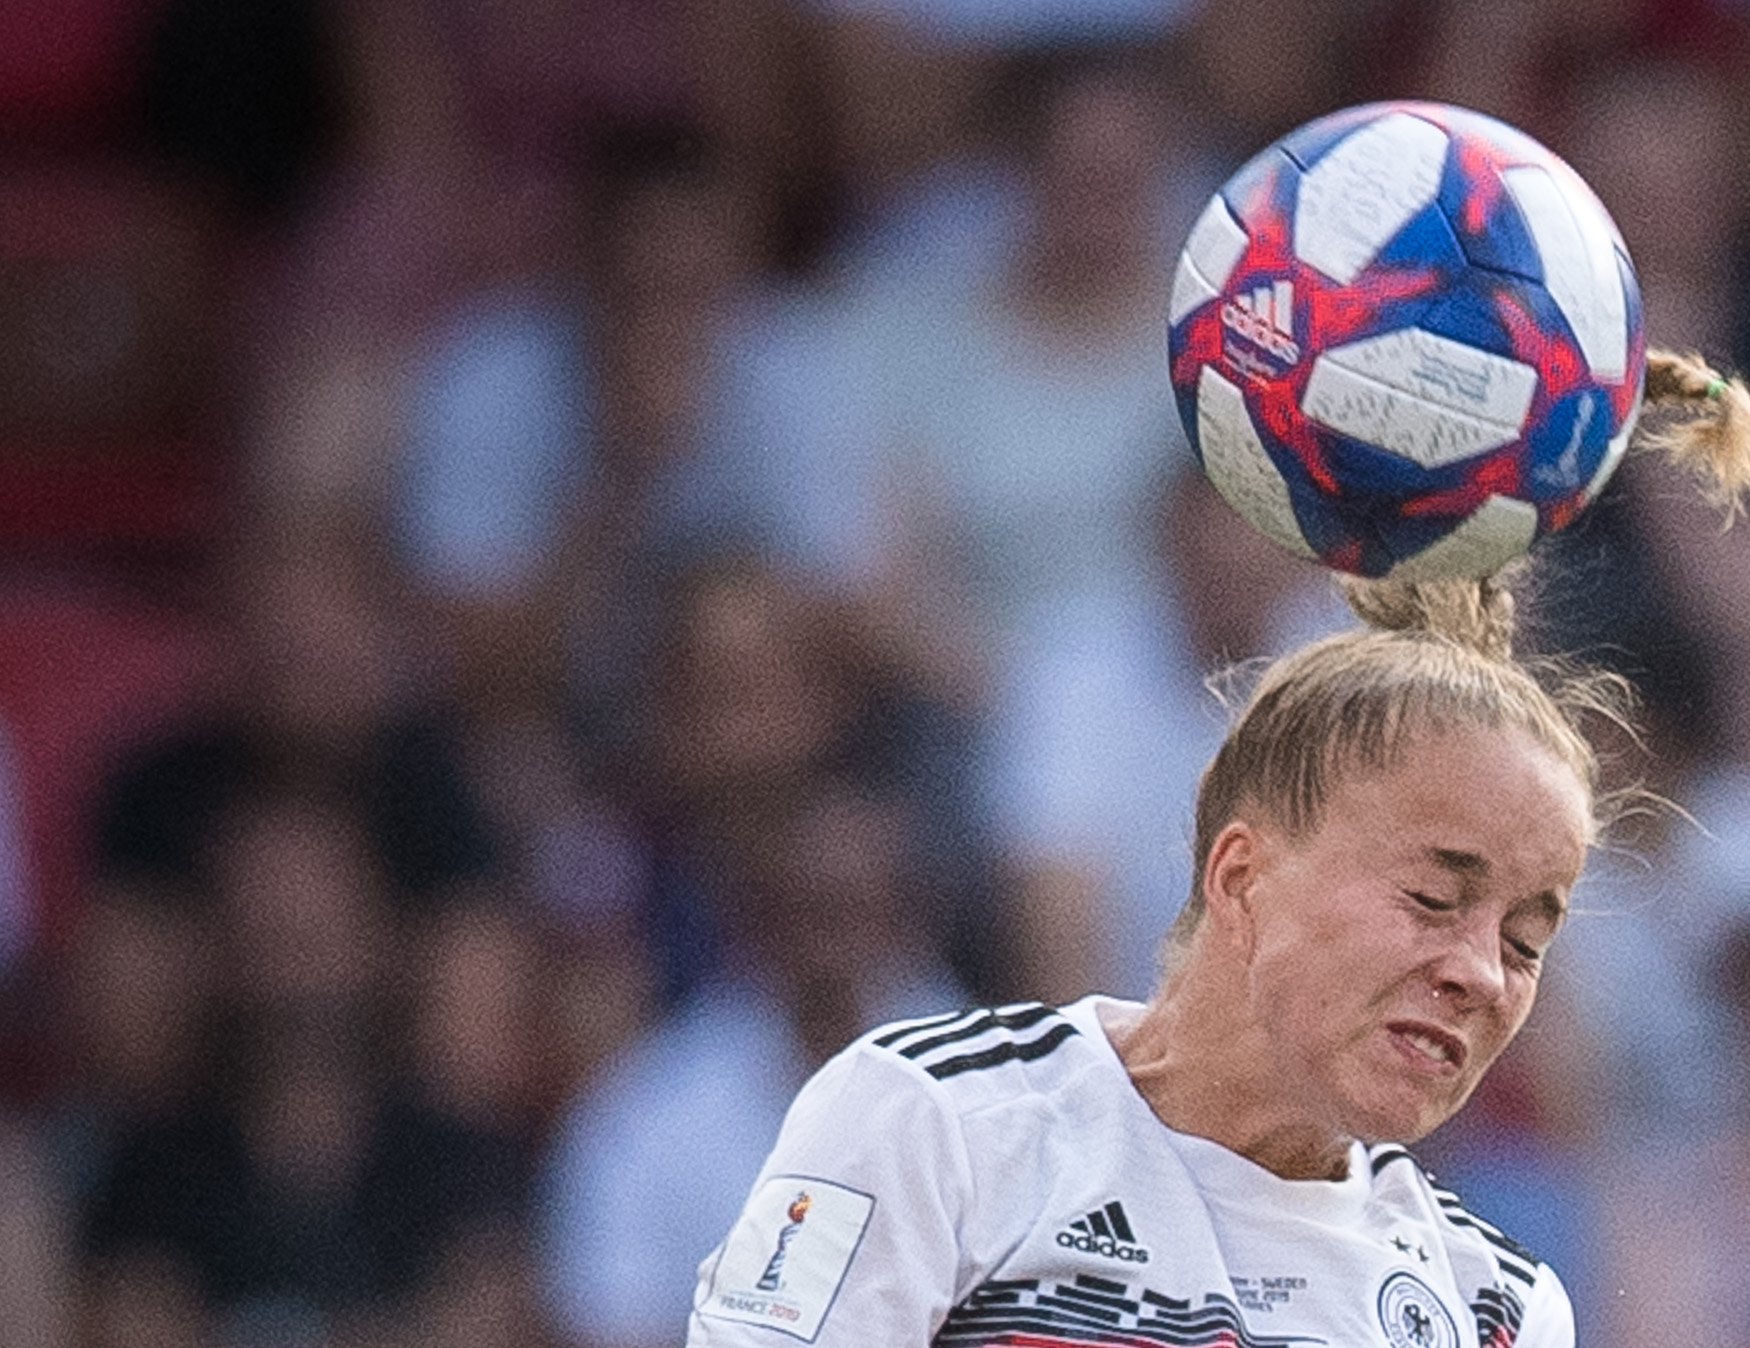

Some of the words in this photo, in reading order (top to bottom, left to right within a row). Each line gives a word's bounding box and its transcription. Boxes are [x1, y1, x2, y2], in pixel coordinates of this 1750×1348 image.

[1221, 302, 1300, 366] adidas
[1056, 1230, 1148, 1263] adidas
[721, 1295, 767, 1315] FRANCE
